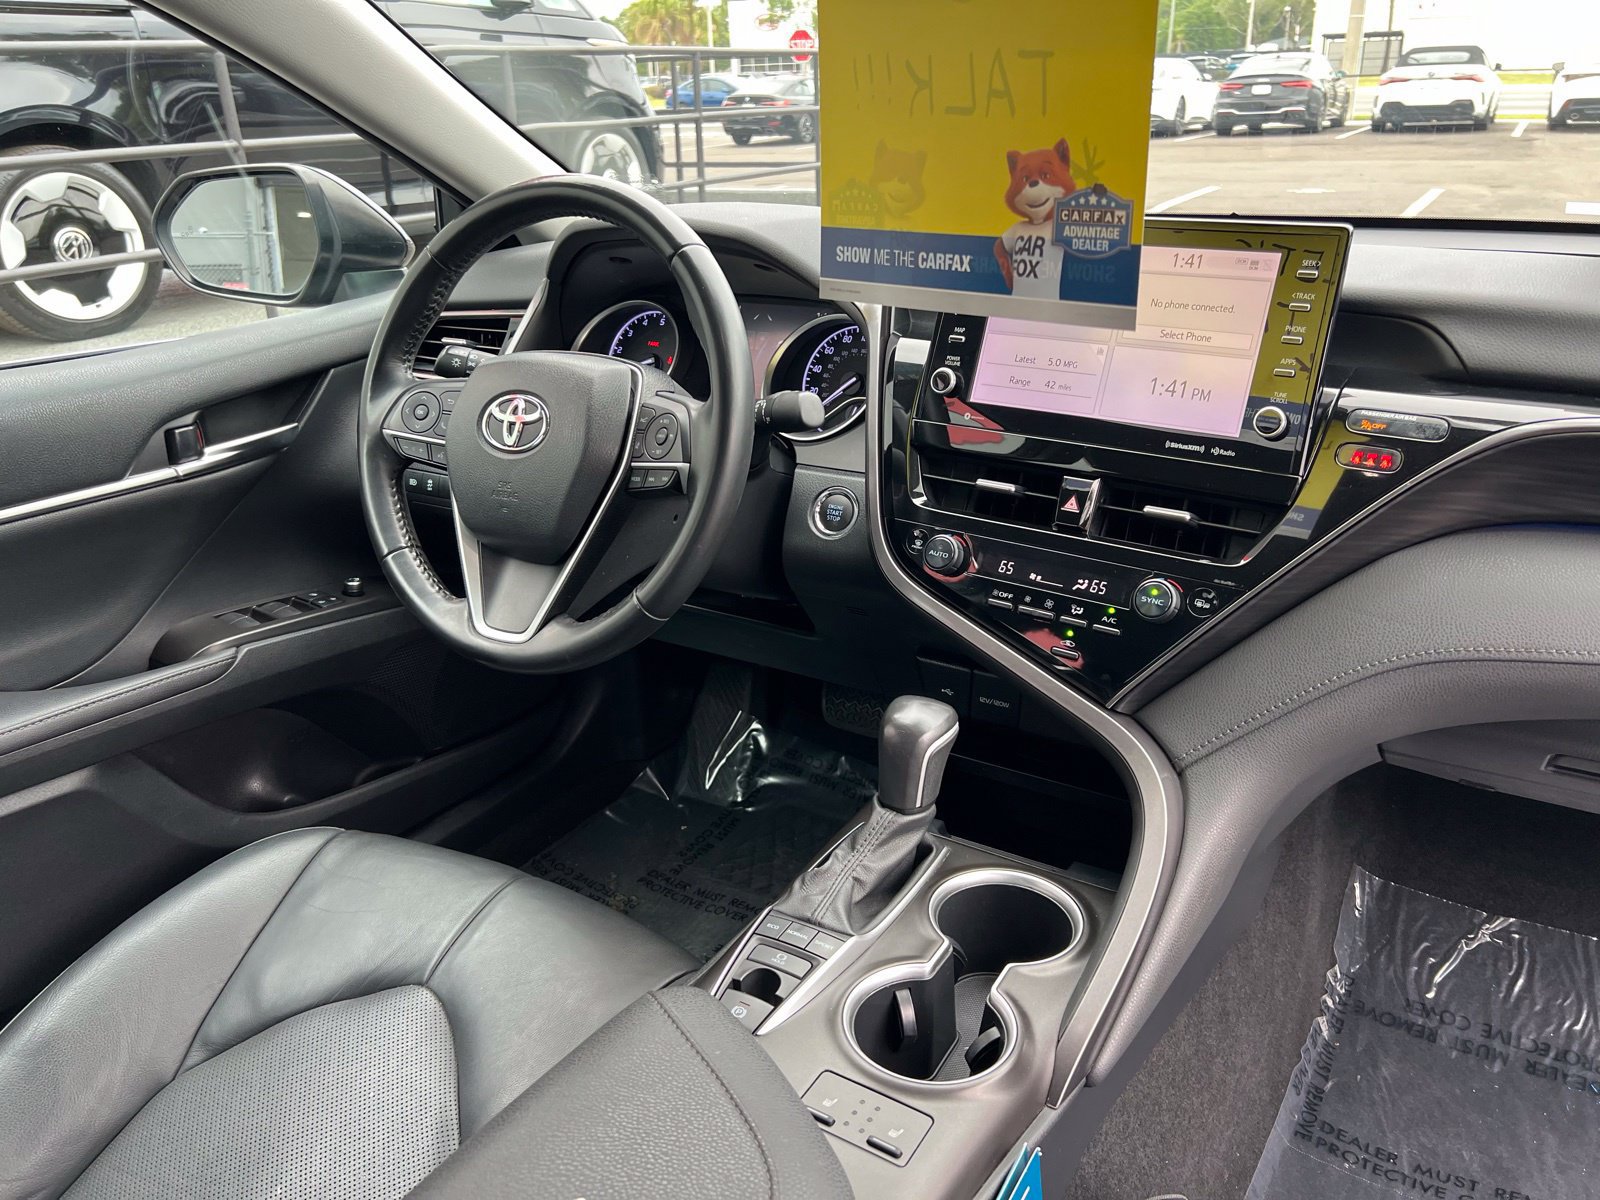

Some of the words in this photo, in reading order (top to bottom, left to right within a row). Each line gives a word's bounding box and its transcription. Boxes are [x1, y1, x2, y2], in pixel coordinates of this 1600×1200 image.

[1060, 210, 1126, 225] CARFAX
[1063, 225, 1121, 240] ADVANTAGE
[1014, 235, 1046, 258] CAR
[1071, 238, 1109, 252] DEALER
[836, 245, 871, 264] SHOW
[873, 247, 891, 266] ME
[893, 249, 915, 268] THE
[918, 251, 972, 273] CARFAX
[1172, 252, 1204, 269] 1:41
[1150, 298, 1163, 308] No
[1164, 300, 1190, 315] phone
[1191, 302, 1236, 314] connected.
[1159, 329, 1185, 341] Select
[1185, 331, 1212, 343] Phone
[1284, 325, 1307, 334] PHONE
[842, 335, 853, 344] 80
[824, 346, 835, 355] 60
[1014, 354, 1036, 365] Latest
[1047, 356, 1062, 367] 5.0
[1062, 360, 1078, 369] MPG
[1279, 358, 1296, 366] APPS
[812, 365, 823, 374] 40
[1009, 375, 1032, 388] Range
[1044, 380, 1056, 390] 42
[1150, 377, 1188, 399] 1:41
[1191, 388, 1212, 403] PM
[826, 509, 844, 517] START
[827, 503, 844, 511] ENGINE
[826, 514, 842, 522] STOP
[928, 549, 949, 559] AUTO
[998, 560, 1015, 575] 65
[1089, 579, 1108, 595] 65
[998, 591, 1014, 600] OFF
[1140, 596, 1165, 607] SYNC
[1101, 615, 1117, 625] A/C
[647, 868, 691, 893] DEALER
[693, 887, 727, 904] MUST
[636, 876, 705, 910] PROTECTIVE
[704, 904, 749, 923] COVER
[766, 923, 780, 931] ECO
[786, 928, 809, 941] NORMAL
[1293, 1082, 1326, 1143] REMOVE
[1319, 1120, 1400, 1167] DEALER
[1411, 1162, 1481, 1193] MUST
[1307, 1135, 1447, 1200] PROTECTIVE
